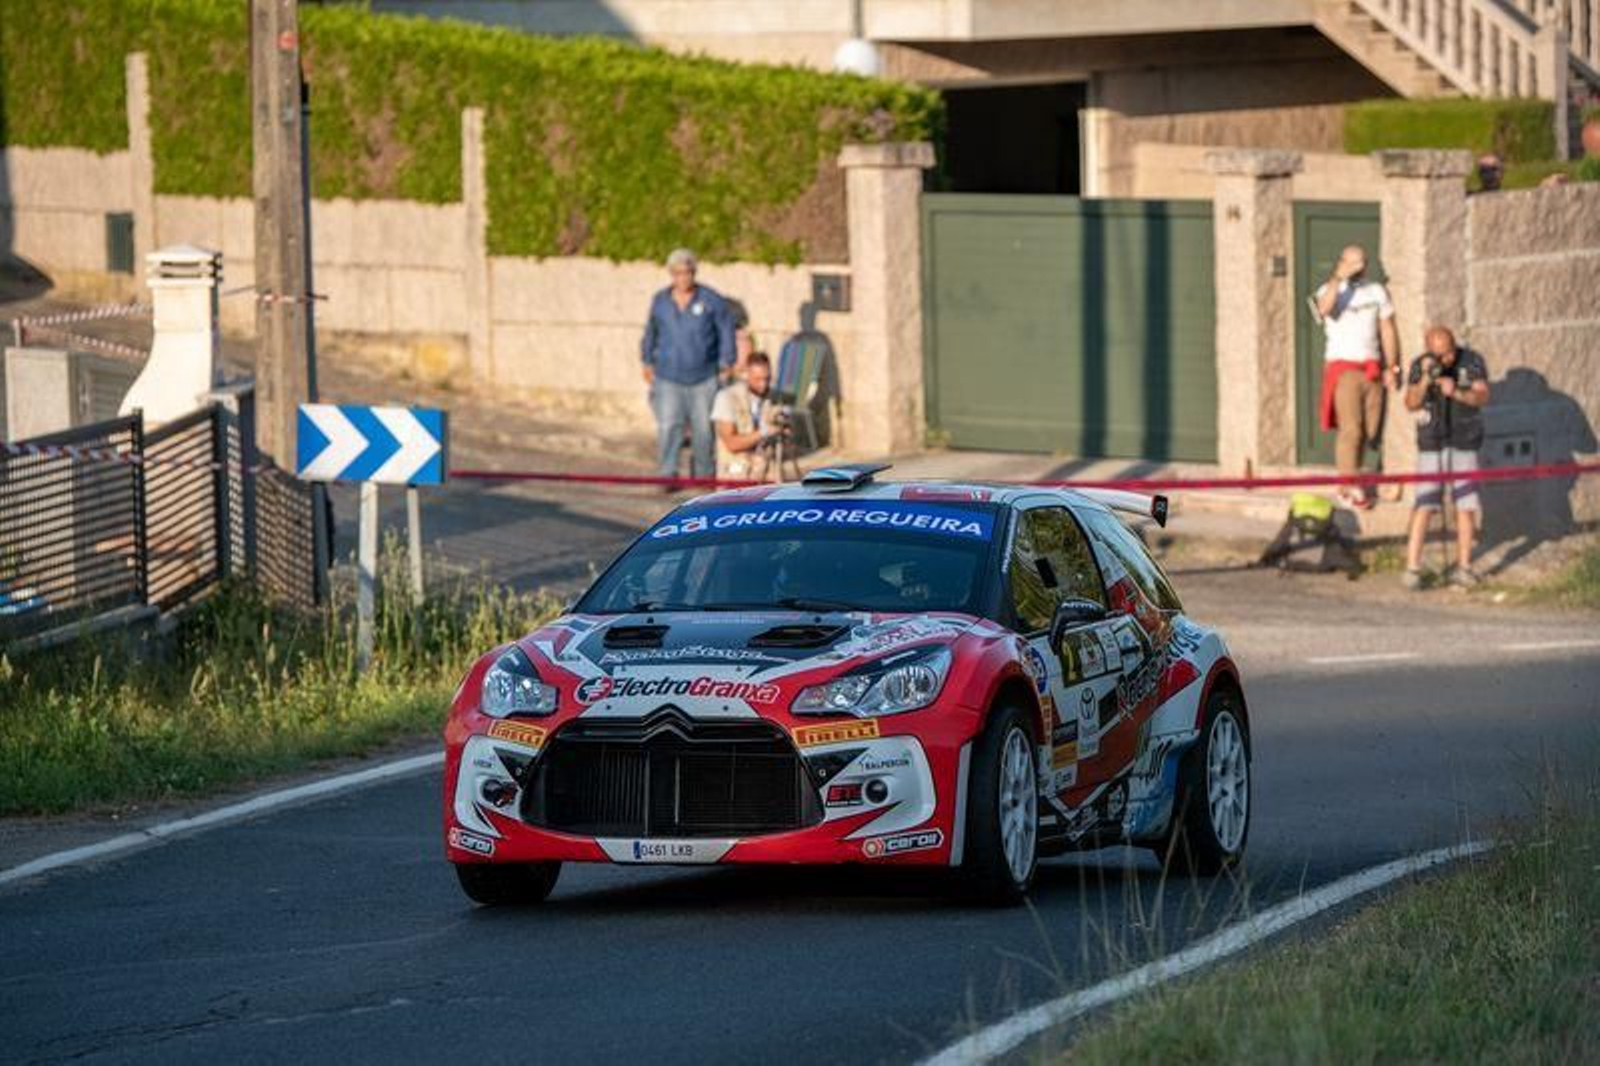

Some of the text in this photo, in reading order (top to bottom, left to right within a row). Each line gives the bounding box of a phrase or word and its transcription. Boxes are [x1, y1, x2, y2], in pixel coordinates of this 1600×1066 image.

[713, 508, 824, 528] GRUPO
[827, 509, 983, 536] REGUEIRA
[491, 722, 543, 746] PIRELLI
[796, 721, 876, 745] PIRELLI
[641, 844, 693, 857] 0461 LKB
